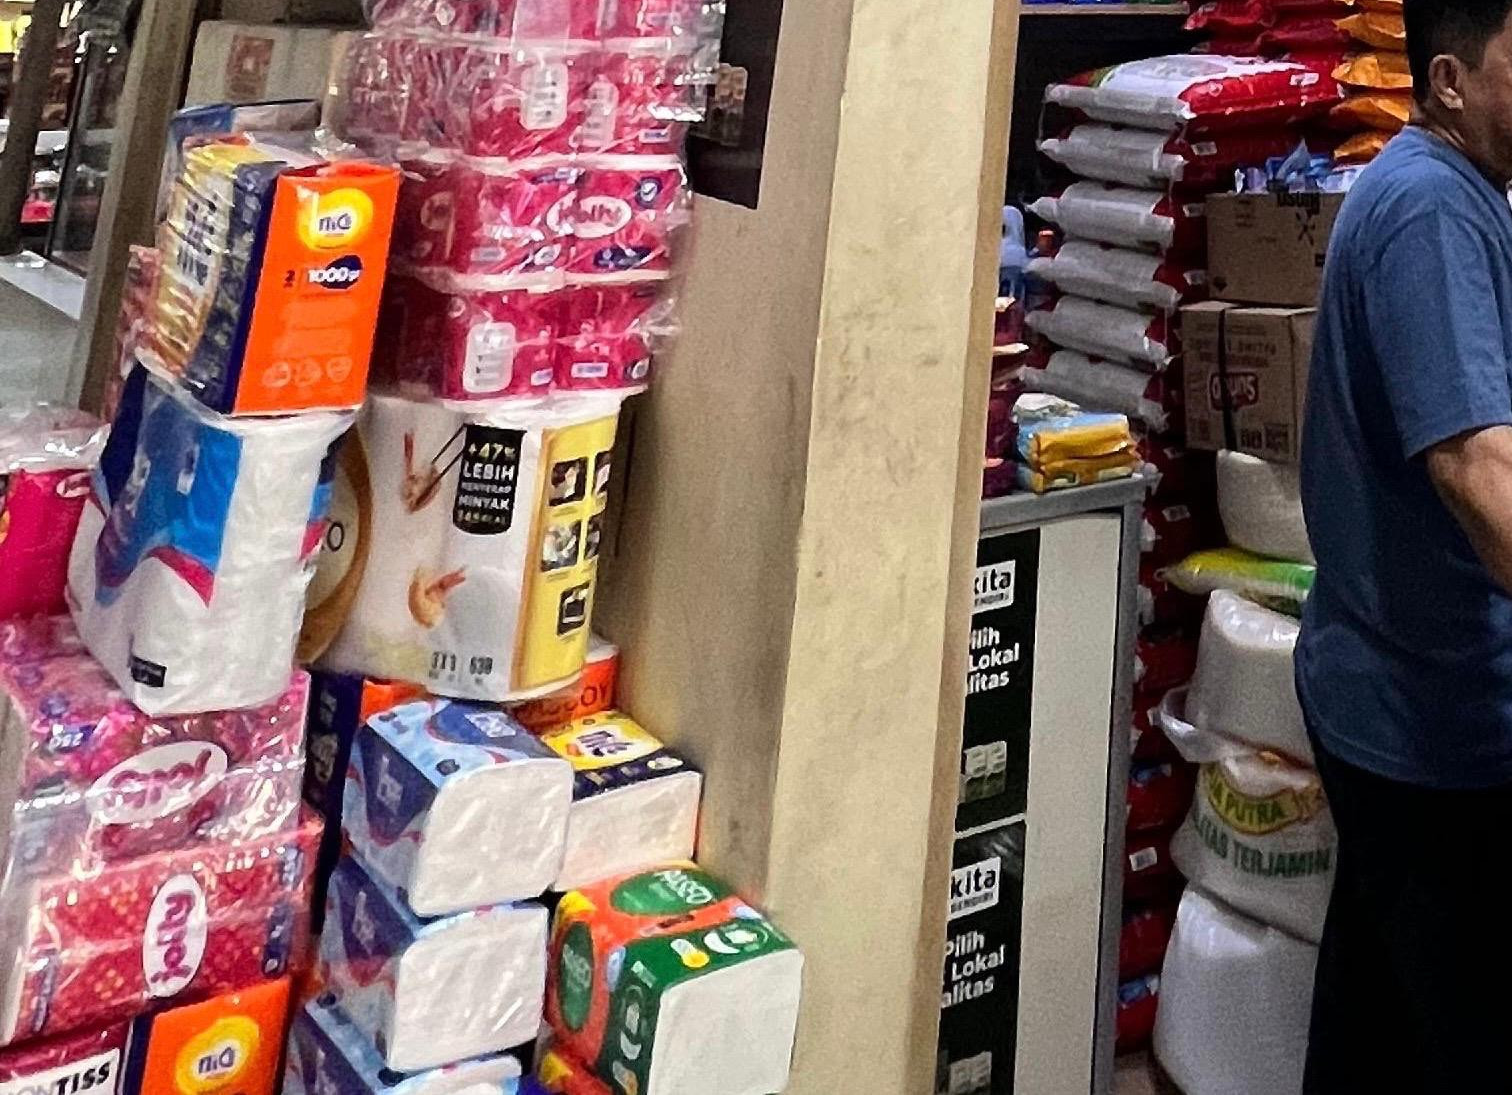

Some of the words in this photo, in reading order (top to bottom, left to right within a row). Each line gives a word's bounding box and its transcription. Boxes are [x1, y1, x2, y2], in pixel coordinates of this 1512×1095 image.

[463, 461, 515, 481] LEBIH
[968, 642, 1020, 673] Lokal
[952, 943, 1006, 981] Lokal
